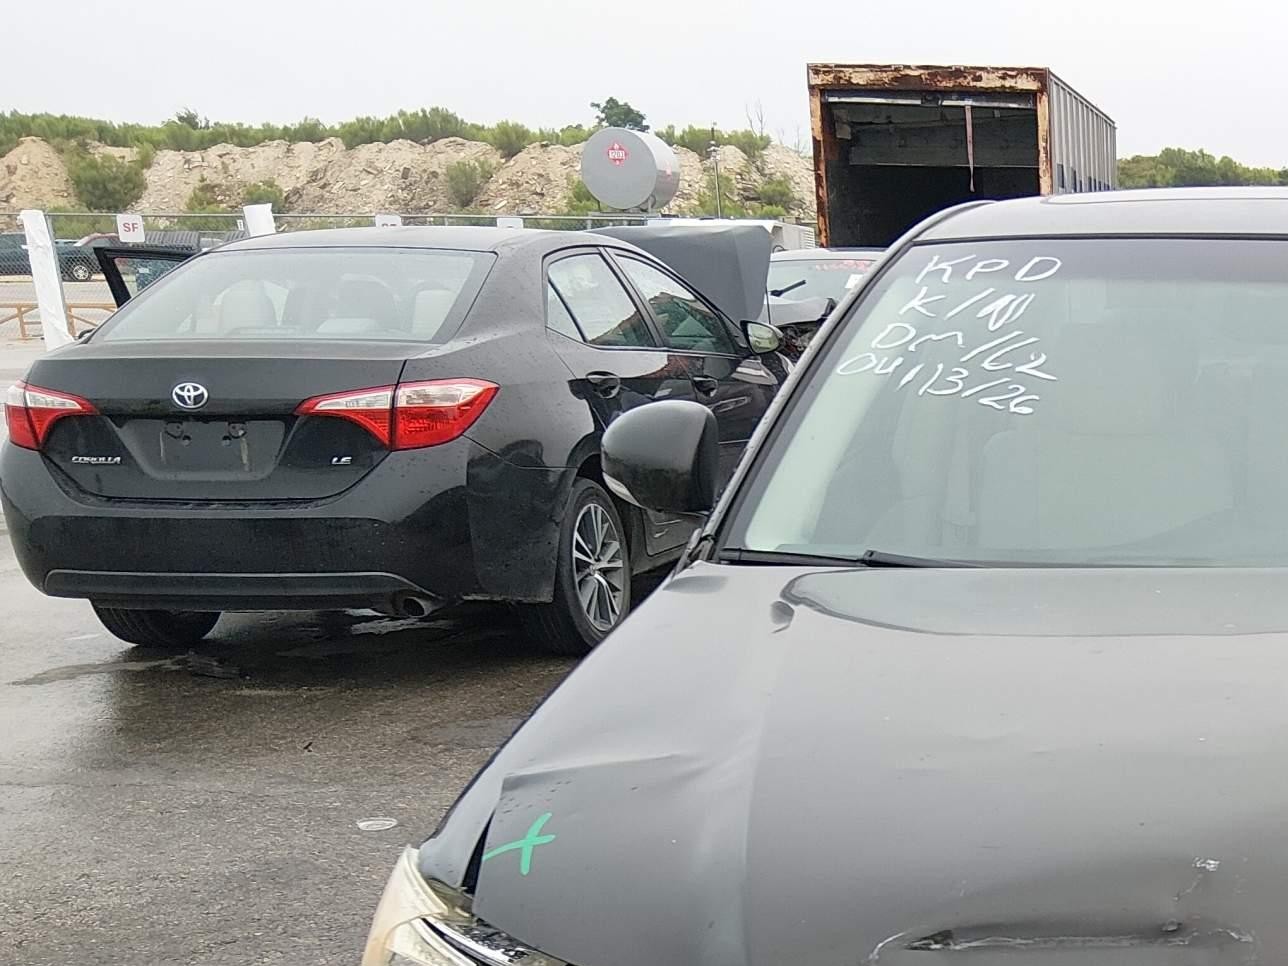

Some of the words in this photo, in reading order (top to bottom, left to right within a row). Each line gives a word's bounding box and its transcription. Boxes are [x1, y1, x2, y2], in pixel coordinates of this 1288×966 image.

[122, 222, 139, 233] SF
[71, 455, 121, 465] COROLLA
[331, 456, 352, 465] LE
